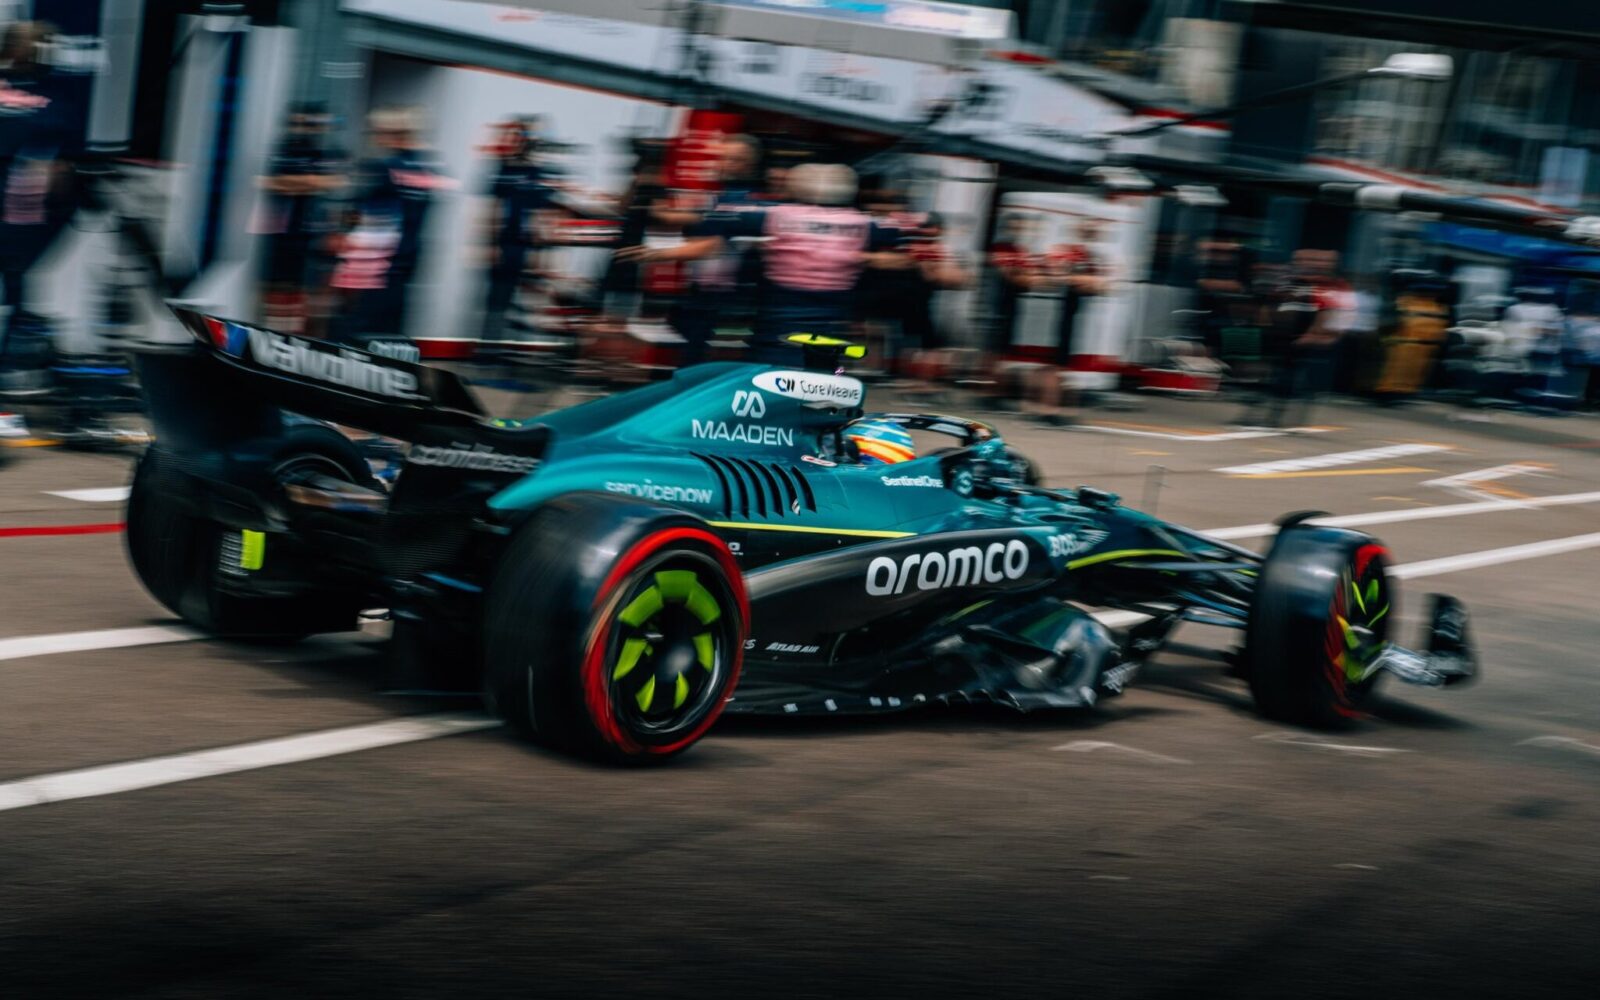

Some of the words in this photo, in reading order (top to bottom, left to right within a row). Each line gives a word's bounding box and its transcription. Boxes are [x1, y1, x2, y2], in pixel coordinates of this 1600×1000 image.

[800, 379, 859, 400] CoreWeave
[692, 418, 794, 447] MAADEN
[605, 478, 713, 504] servicenow
[865, 539, 1029, 596] aramco
